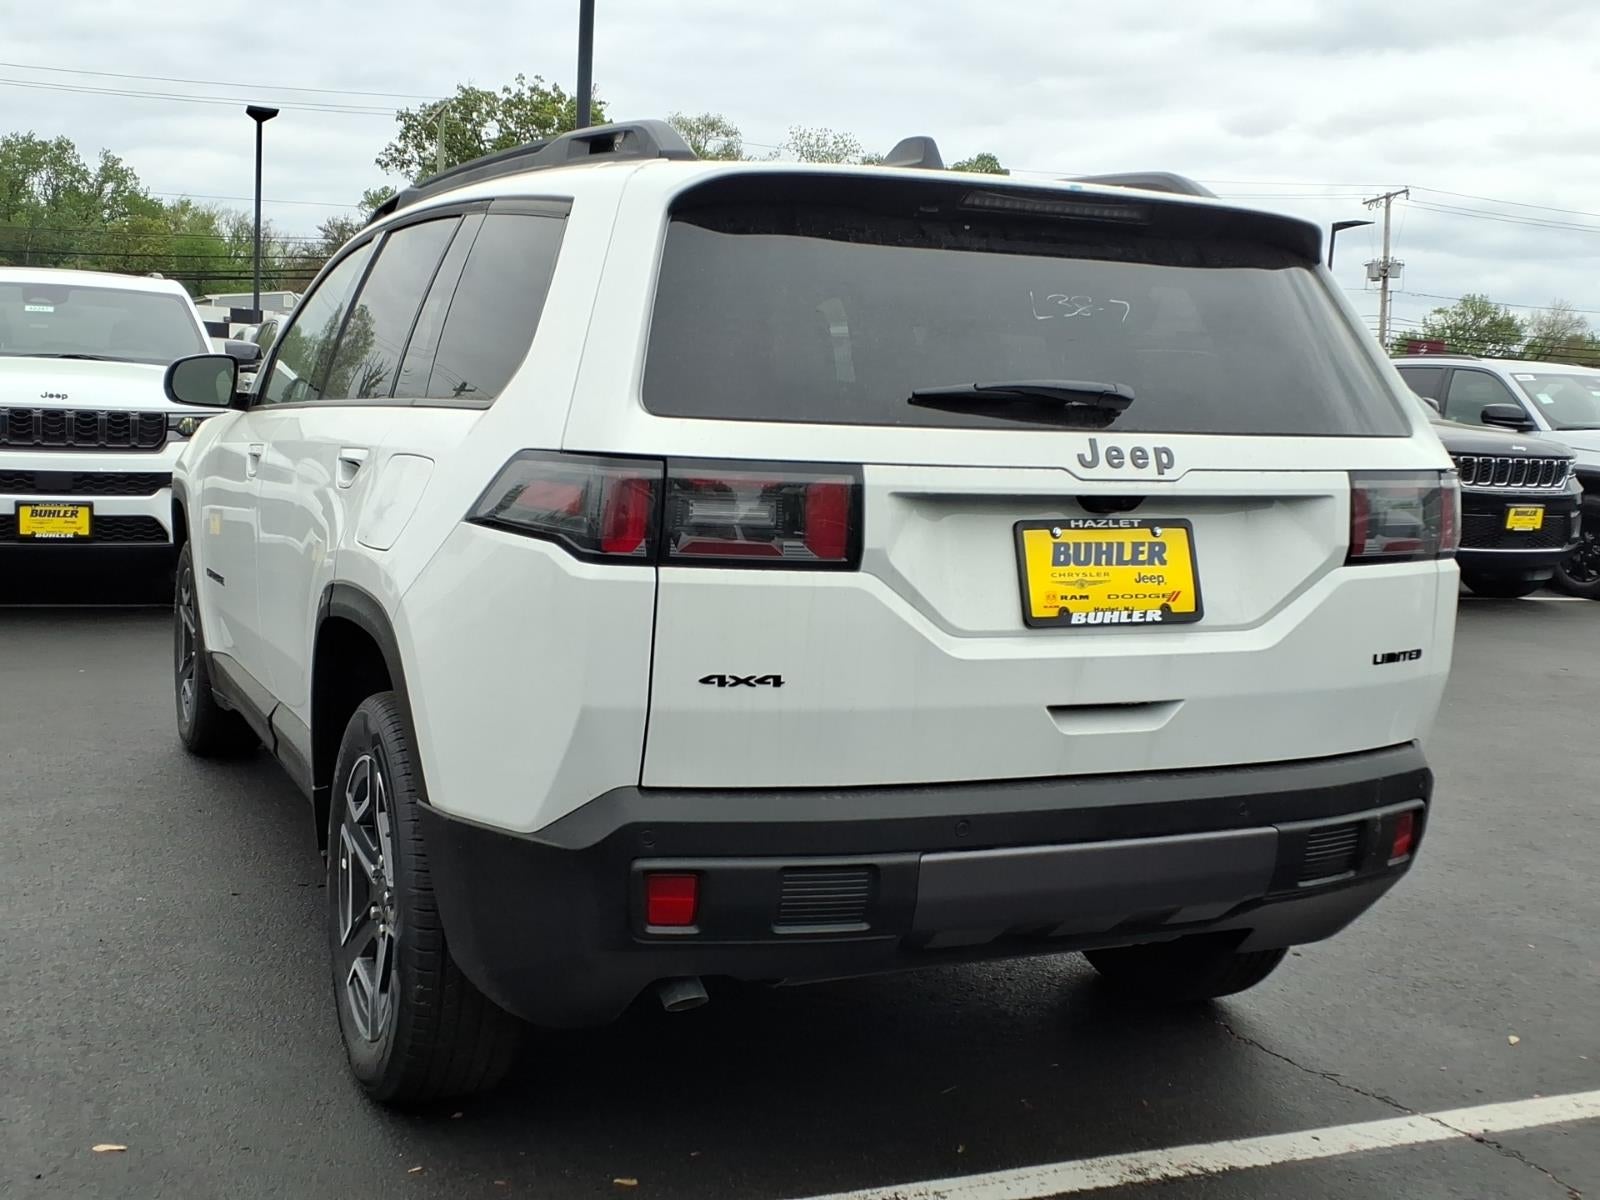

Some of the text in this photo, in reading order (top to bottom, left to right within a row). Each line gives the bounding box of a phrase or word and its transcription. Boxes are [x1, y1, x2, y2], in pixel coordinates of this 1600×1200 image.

[40, 391, 69, 400] Jeep
[1077, 437, 1175, 476] Jeep
[30, 509, 79, 518] BUHLER
[1070, 519, 1142, 528] HAZLET
[1051, 541, 1168, 567] BUHLER
[1134, 572, 1165, 586] Jeep
[1107, 592, 1173, 600] DODGE
[1071, 609, 1163, 625] BUHLER
